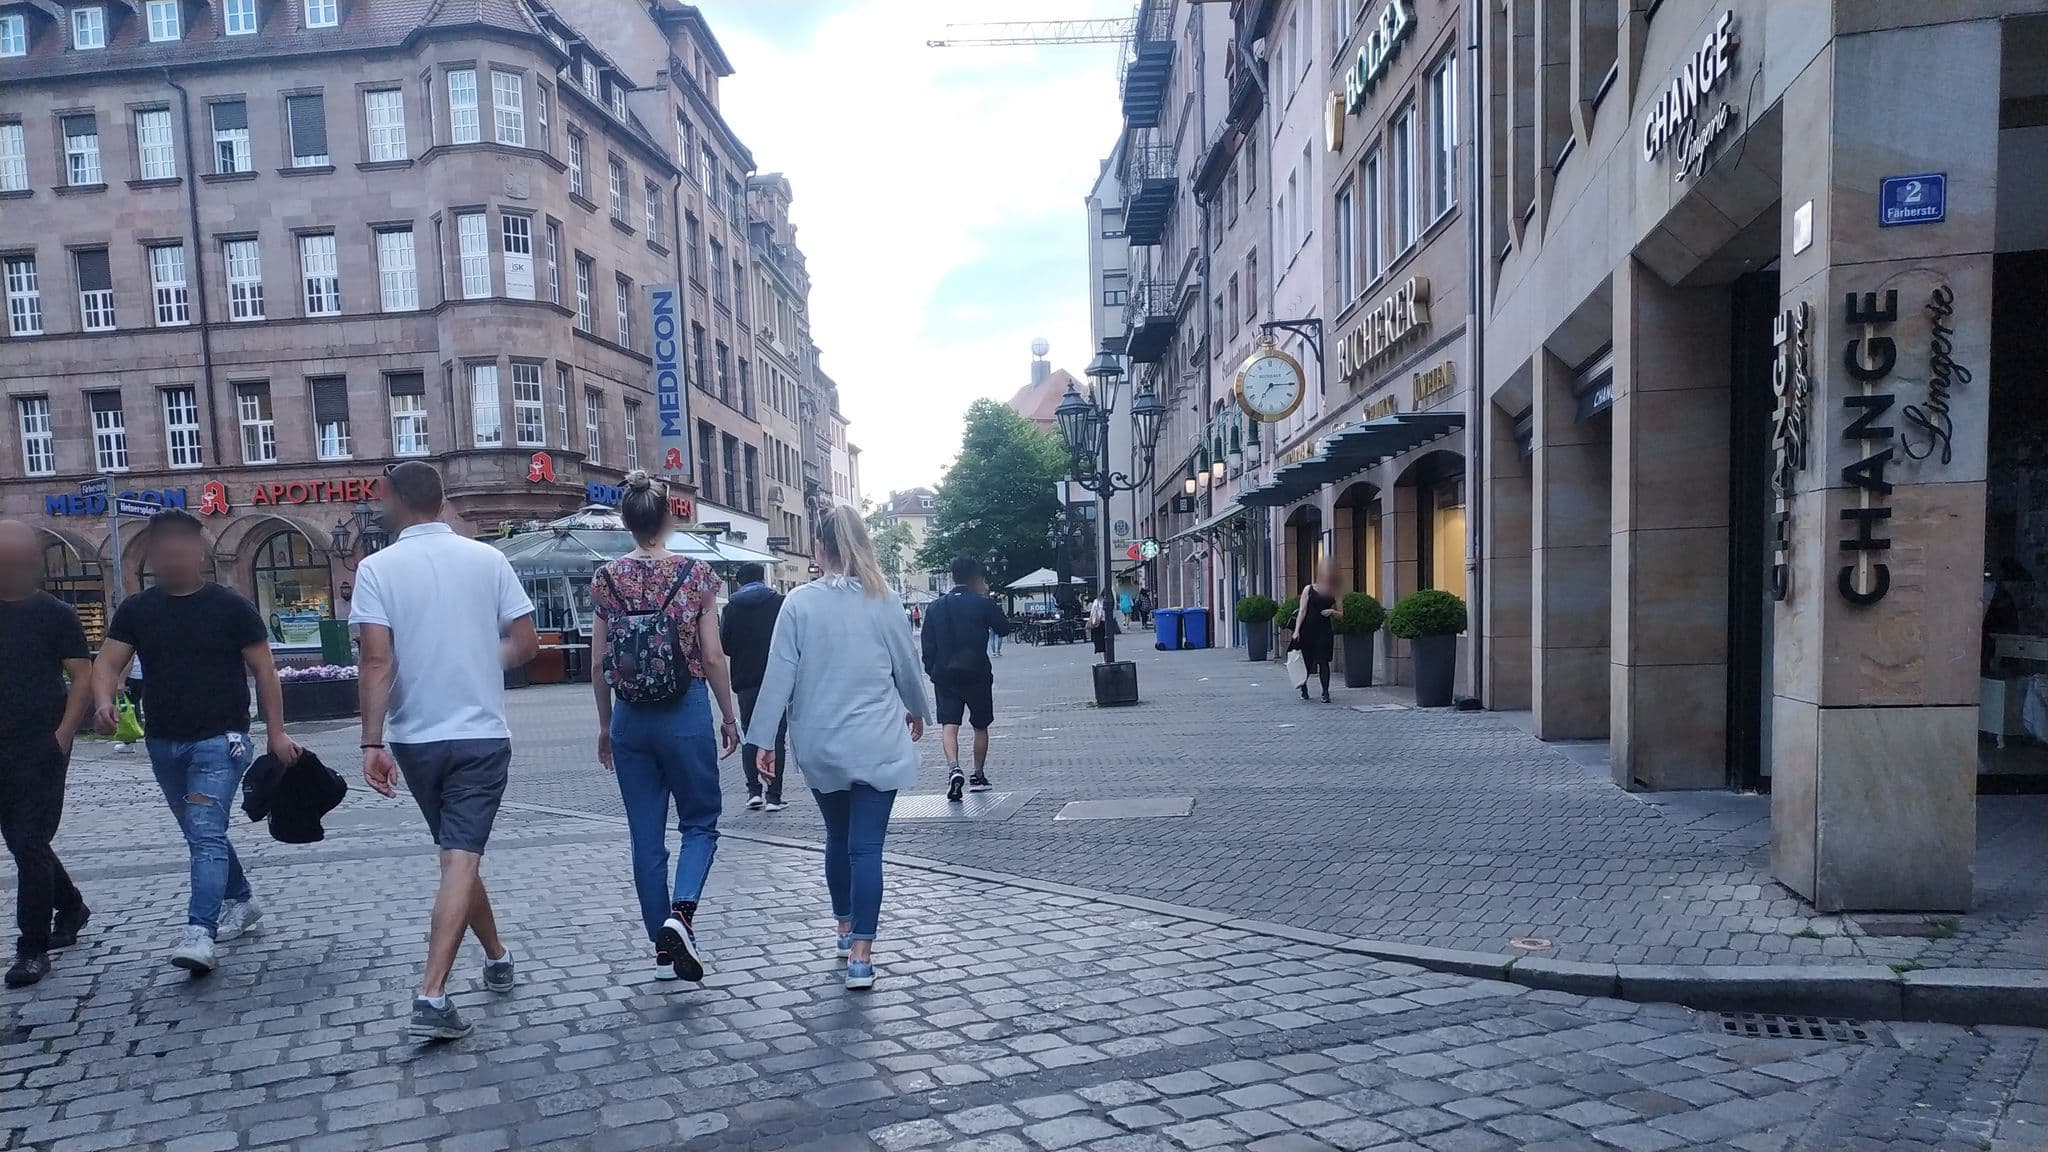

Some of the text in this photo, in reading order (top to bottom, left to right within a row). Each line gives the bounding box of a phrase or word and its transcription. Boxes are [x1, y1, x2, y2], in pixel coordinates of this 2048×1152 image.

[1346, 0, 1416, 115] ROLEX
[1643, 10, 1736, 163] CHANGE
[1675, 101, 1734, 182] Lingerie
[1905, 181, 1922, 203] 2
[1887, 206, 1939, 220] Färberstr.
[652, 290, 682, 437] MEDICON
[1337, 276, 1429, 383] BUCHERER
[1901, 285, 1972, 465] Lingerie
[1771, 309, 1793, 601] CHANGE
[1838, 289, 1898, 605] CHANGE
